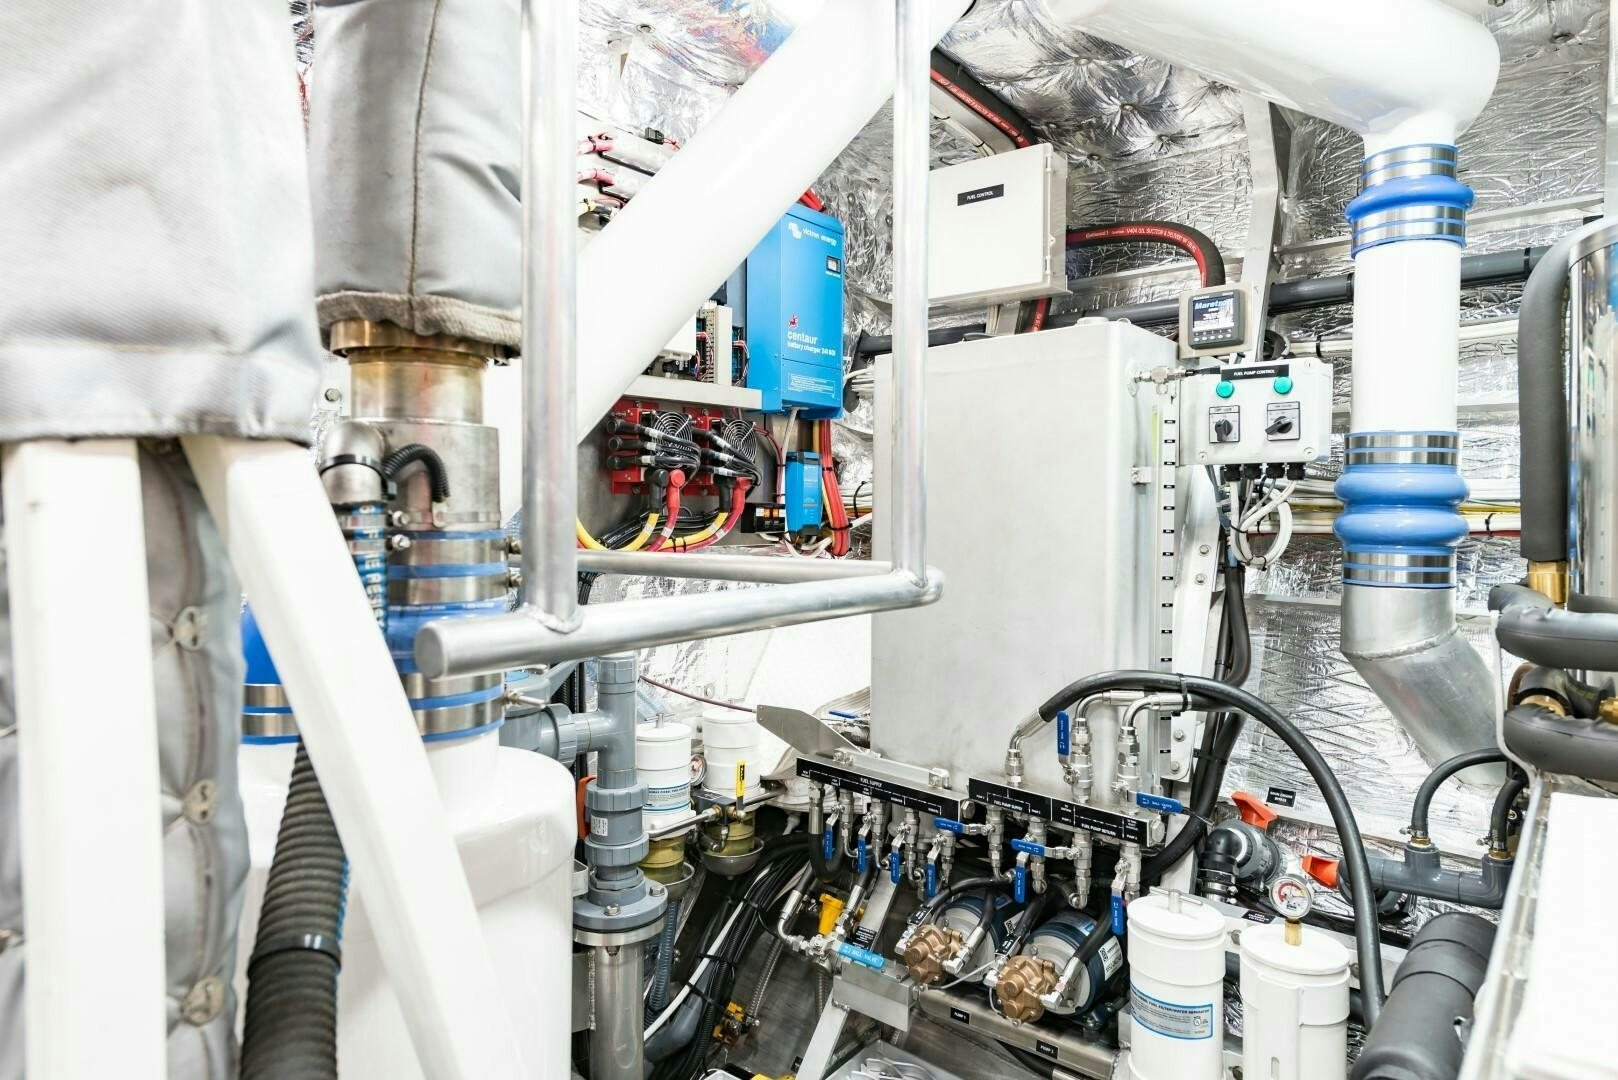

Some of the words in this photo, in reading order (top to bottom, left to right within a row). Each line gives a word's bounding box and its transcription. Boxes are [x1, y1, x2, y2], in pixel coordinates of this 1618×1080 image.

[802, 226, 820, 239] victron
[821, 235, 837, 247] energy
[1195, 300, 1228, 309] Maretro
[787, 331, 818, 344] centaur
[787, 340, 803, 351] battery
[1101, 828, 1116, 836] RETURN
